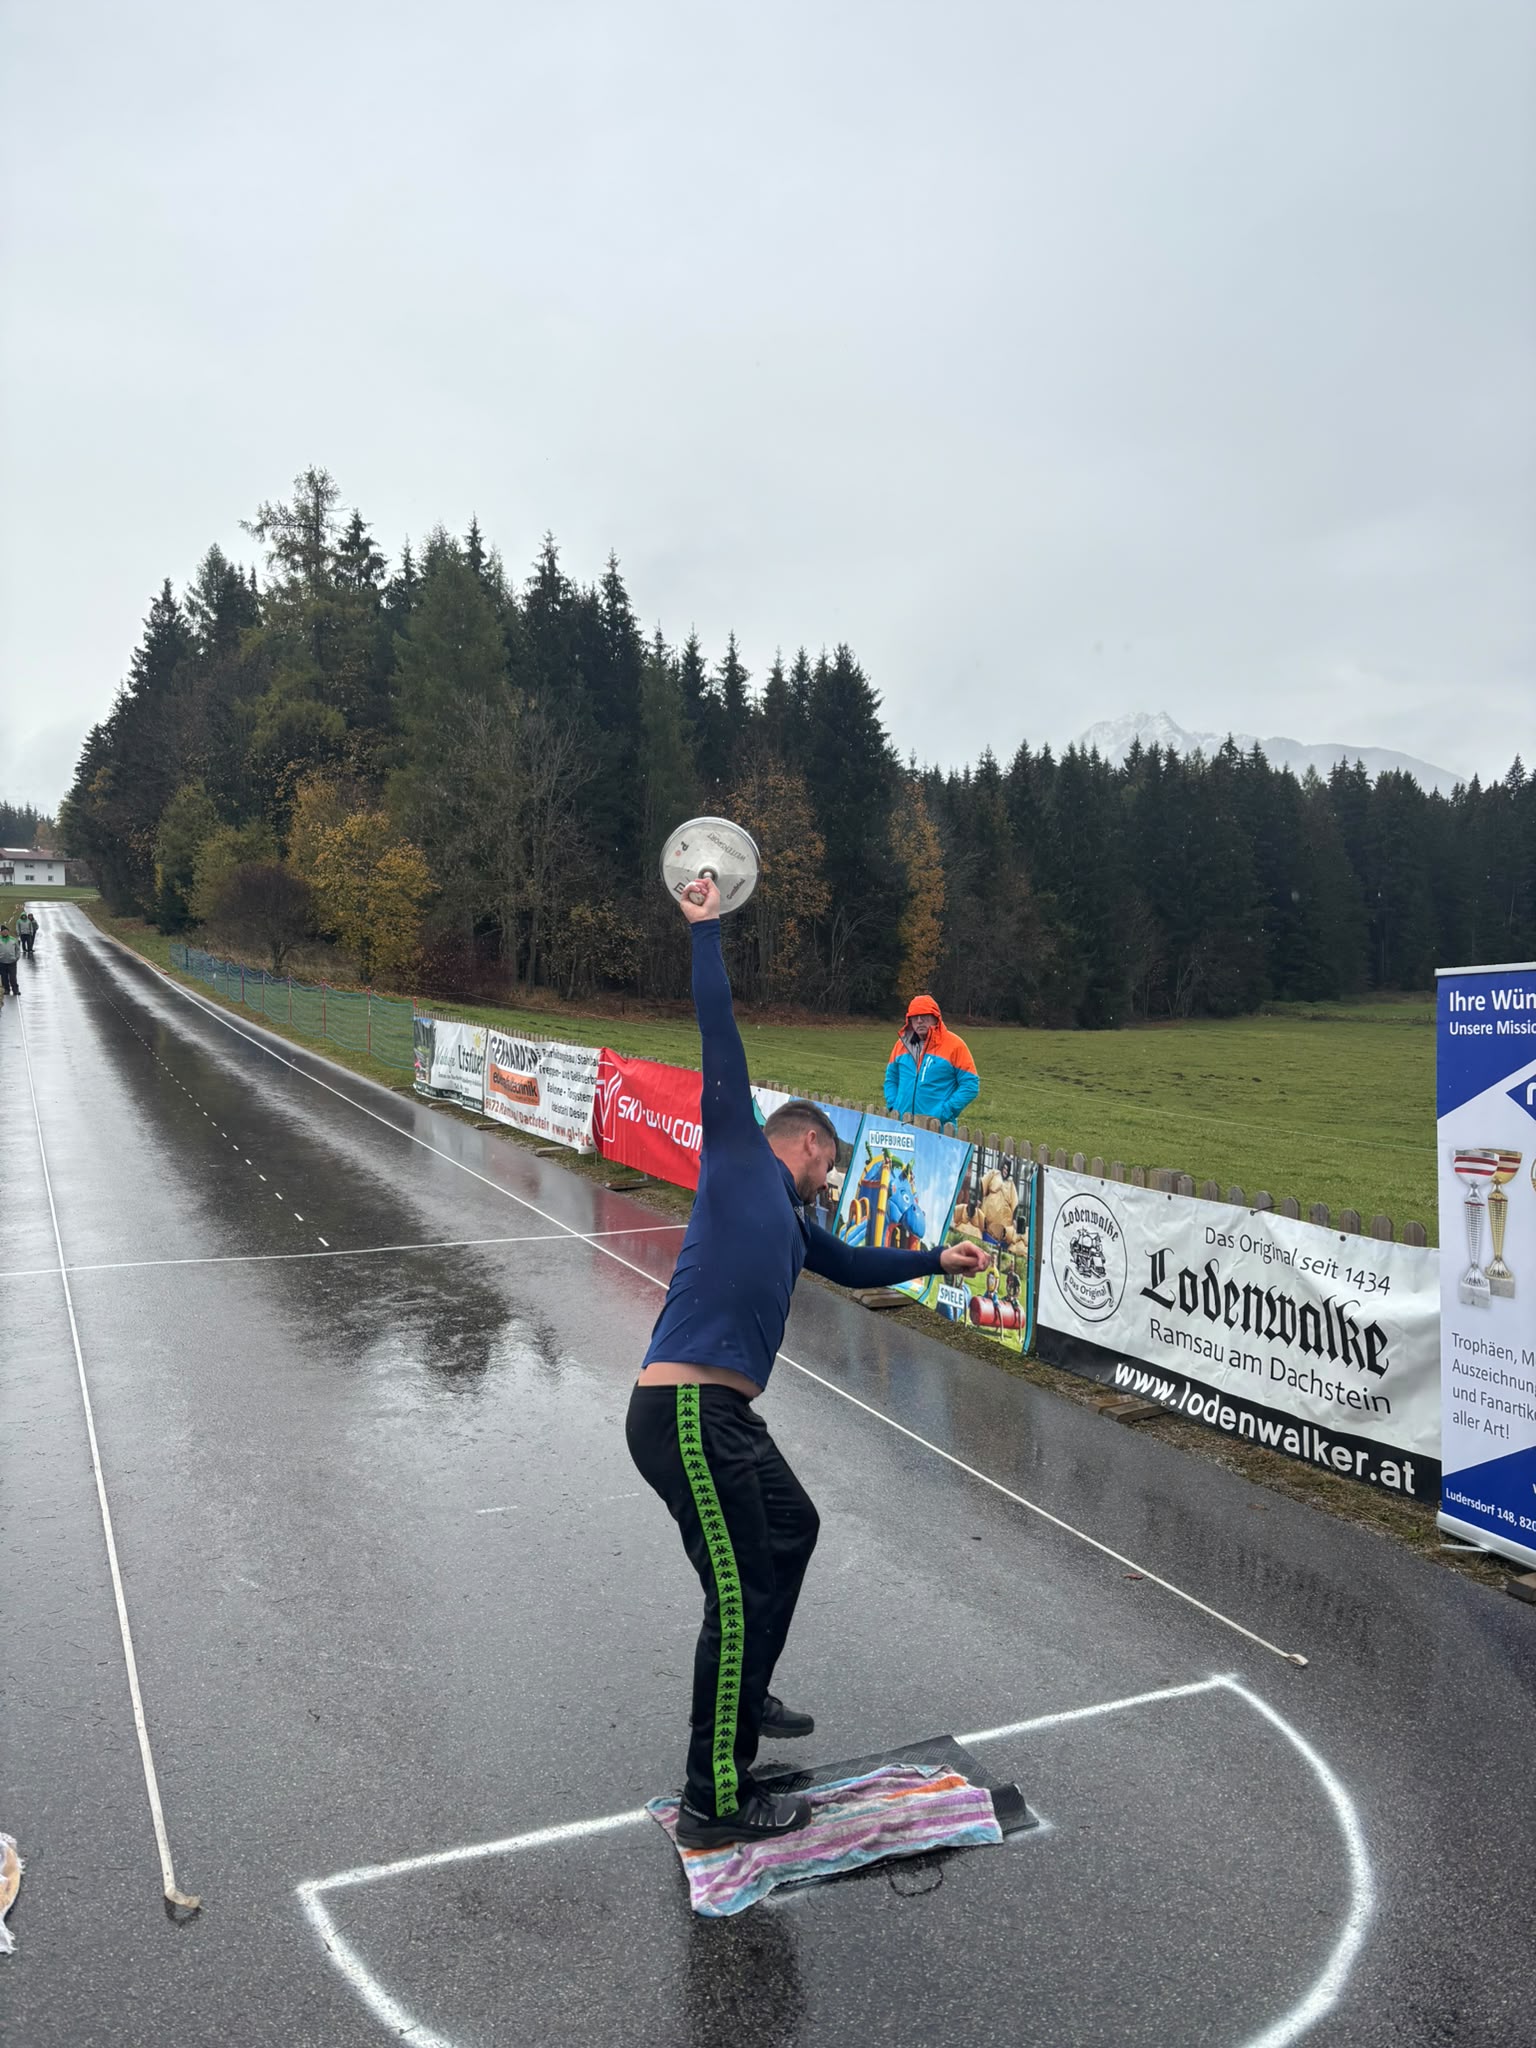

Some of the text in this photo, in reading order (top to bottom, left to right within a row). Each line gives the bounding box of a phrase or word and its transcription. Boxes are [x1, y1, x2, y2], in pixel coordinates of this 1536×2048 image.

[1449, 990, 1486, 1012] Ihre
[1449, 1021, 1493, 1036] Unsere
[870, 1131, 915, 1150] HÜPFBURGEN
[1205, 1226, 1392, 1297] Das Original seit 1434
[940, 1289, 965, 1306] SPIELE
[1068, 1276, 1107, 1300] Das Original
[1139, 1247, 1391, 1380] Lodenwalke
[1451, 1332, 1536, 1368] Trophäen, M
[1150, 1318, 1392, 1415] Ramsau am Dachstein
[1453, 1386, 1477, 1404] und
[1114, 1362, 1417, 1496] www.lodenwalker.at
[1453, 1410, 1511, 1440] aller Art!
[1446, 1487, 1496, 1517] Ludersdorf
[1497, 1507, 1518, 1528] 148,
